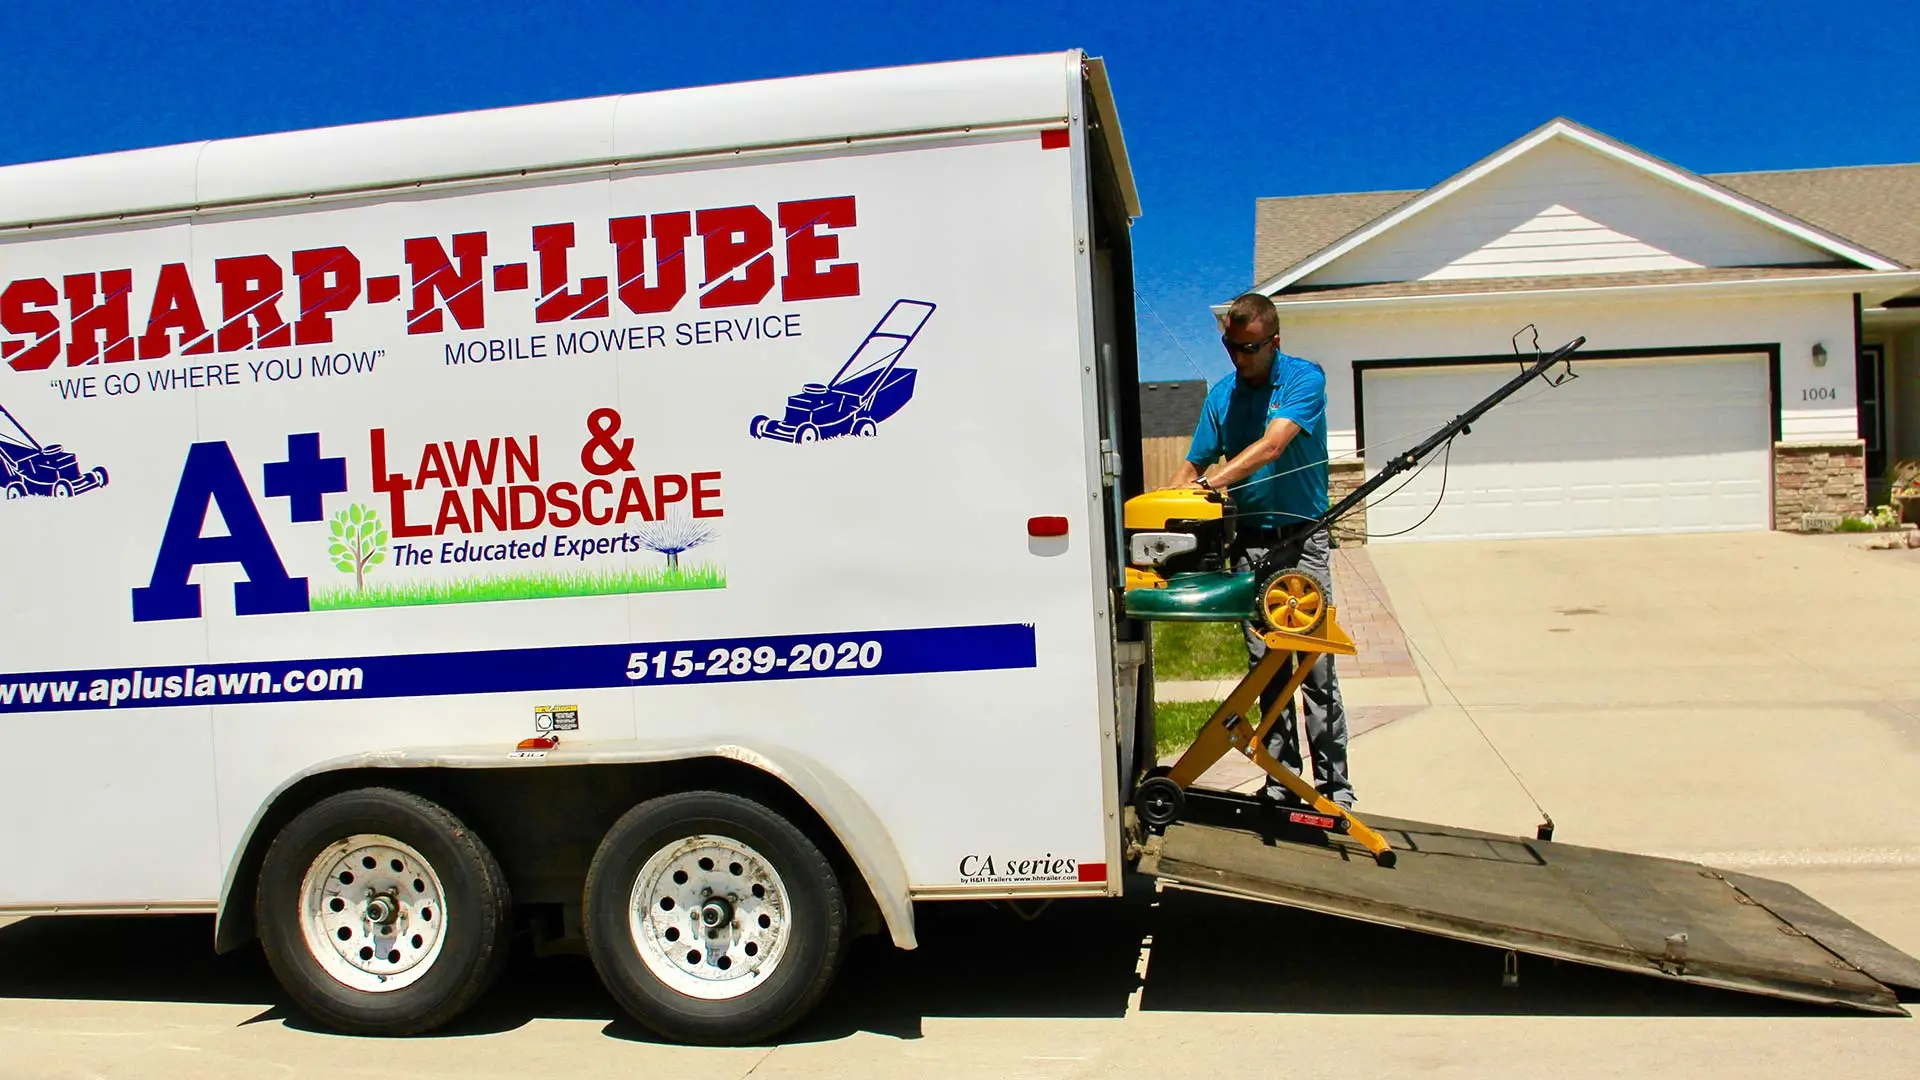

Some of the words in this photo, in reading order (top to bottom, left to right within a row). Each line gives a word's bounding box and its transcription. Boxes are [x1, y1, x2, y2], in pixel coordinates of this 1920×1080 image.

[0, 195, 860, 371] SHARP-N-LUBE
[445, 336, 547, 365] MOBILE
[556, 326, 665, 355] MOWER
[675, 314, 802, 345] SERVICE
[104, 373, 140, 395] GO
[148, 364, 240, 391] WHERE
[248, 358, 302, 382] YOU
[1802, 388, 1836, 401] 1004
[370, 428, 540, 492] LAWN
[581, 407, 636, 475] &
[390, 471, 725, 538] LANDSCAPE
[132, 432, 348, 622] A+
[393, 543, 433, 567] The
[440, 534, 547, 564] Educated
[554, 533, 641, 561] Experts
[626, 640, 883, 680] 515-289-2020
[0, 667, 364, 706] www.apluslawn.com
[959, 855, 996, 877] CA
[1006, 853, 1076, 875] series
[1013, 874, 1078, 882] www.hhtrailer.com
